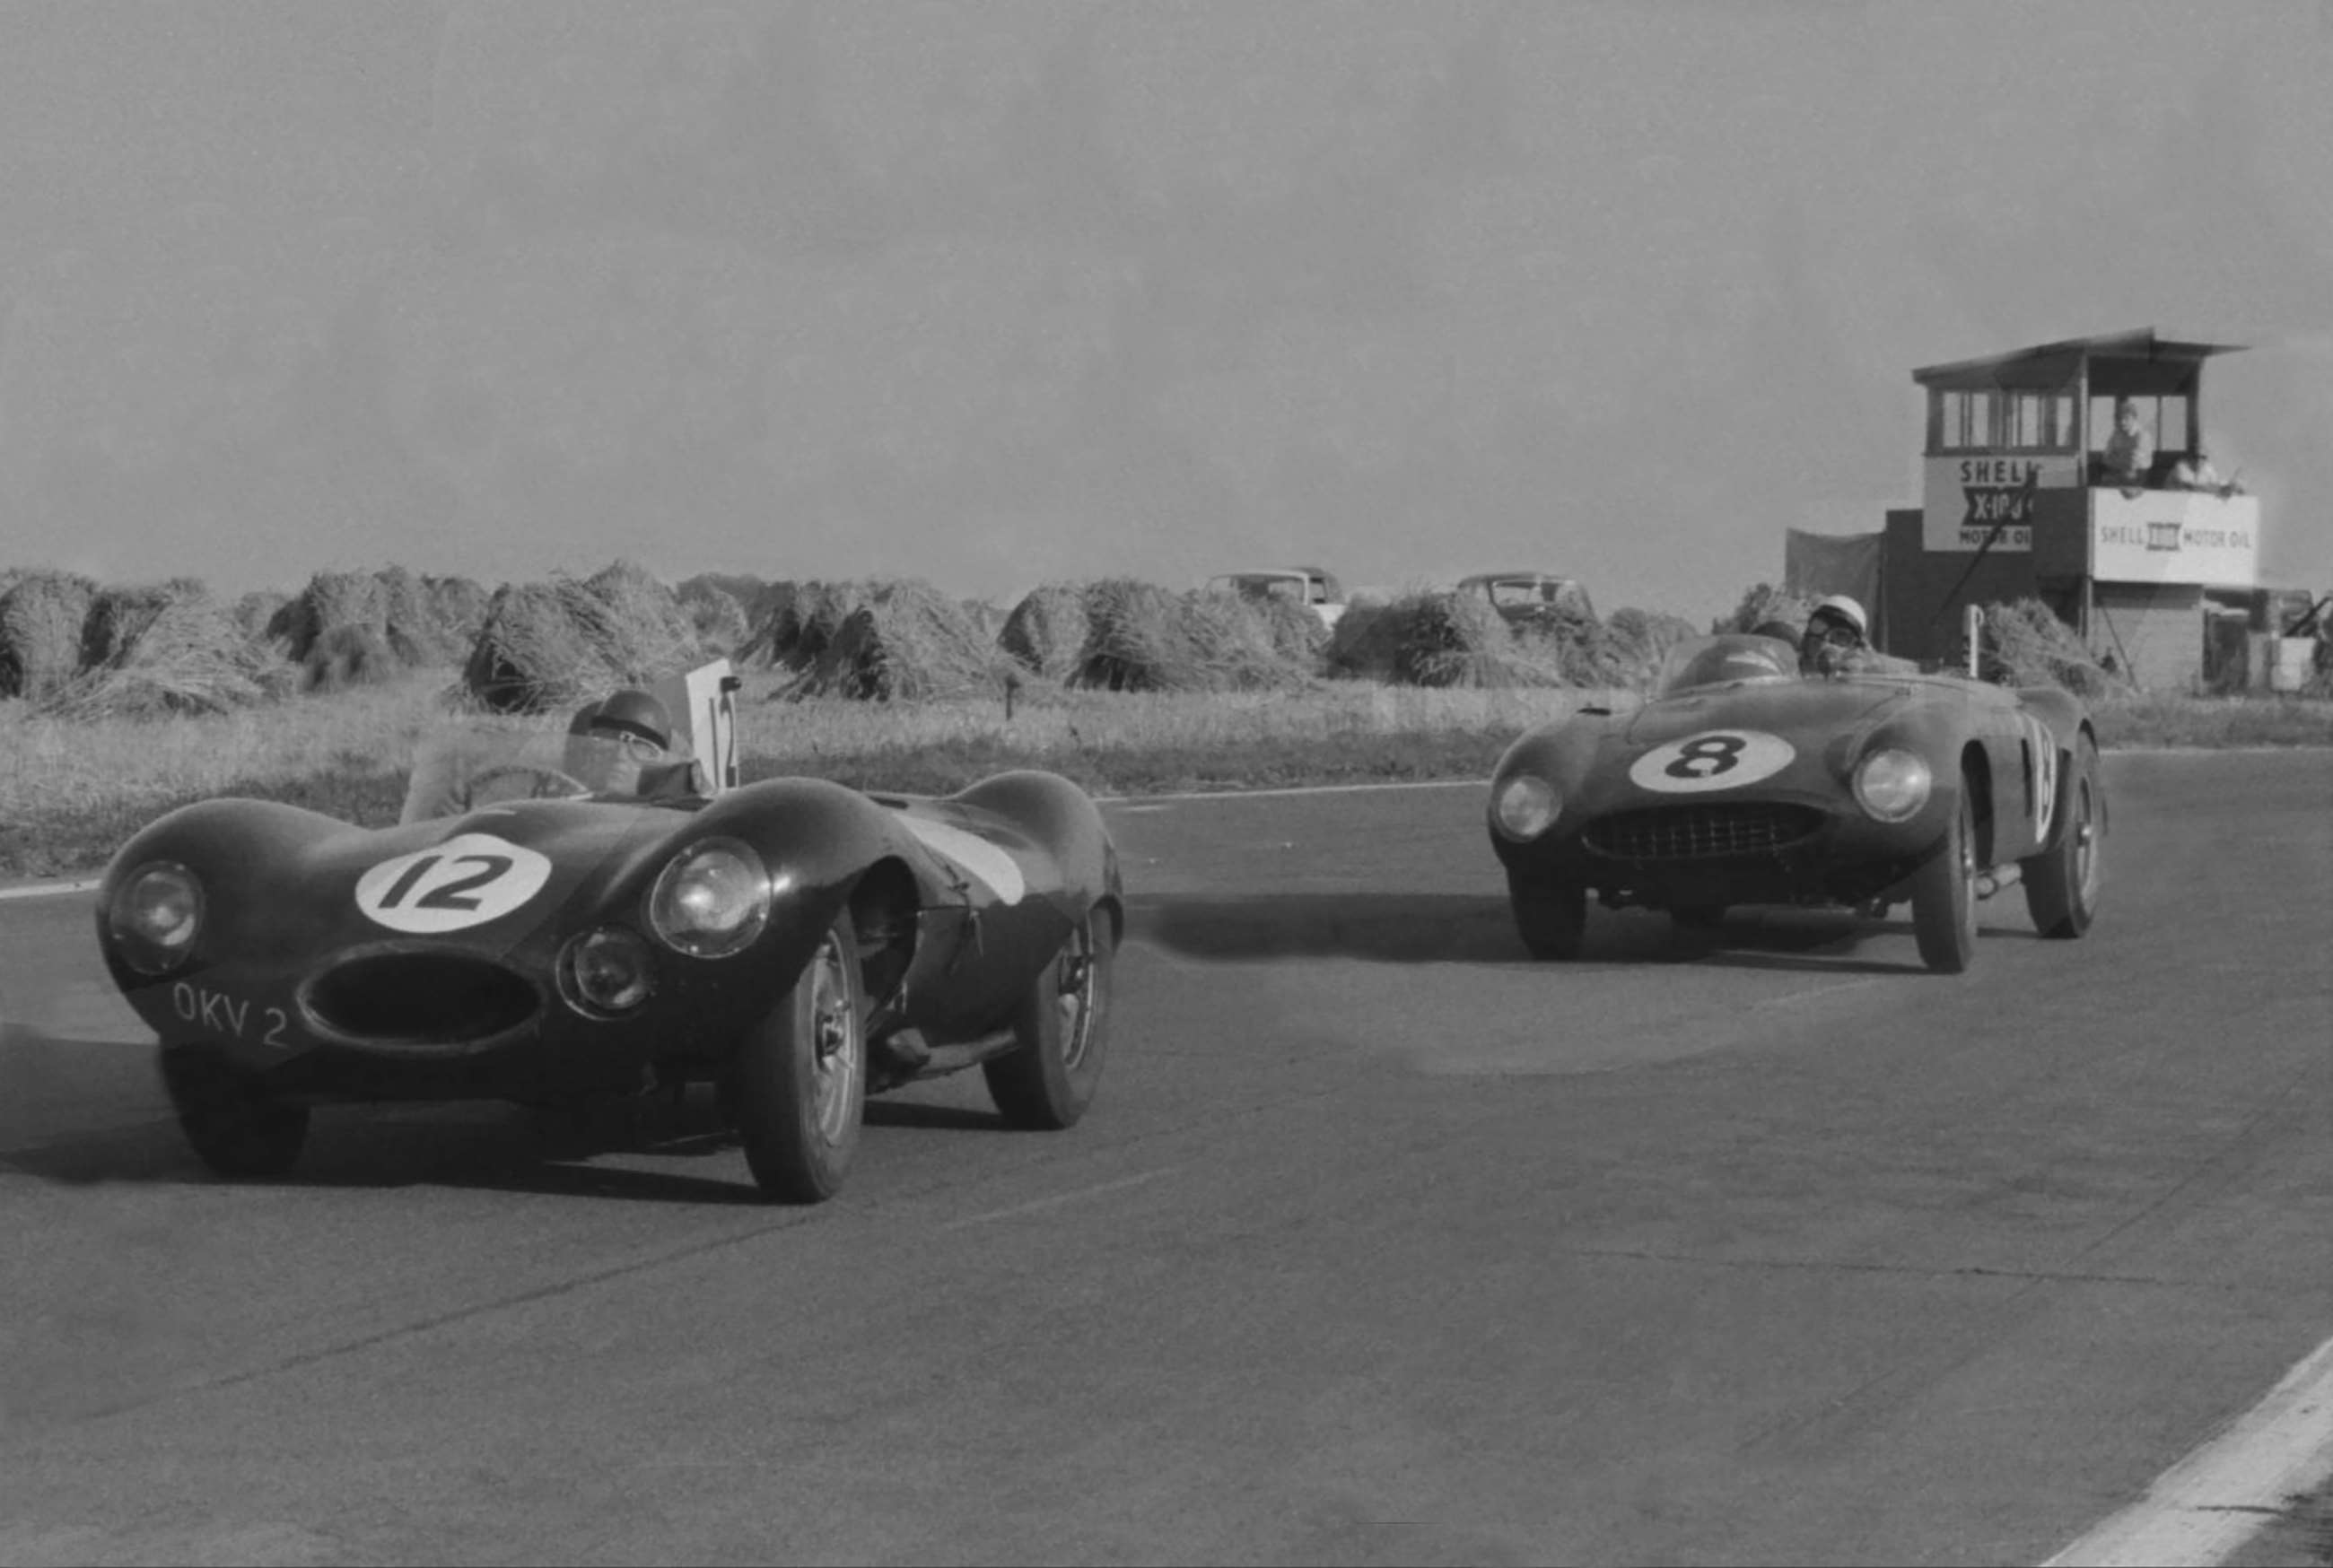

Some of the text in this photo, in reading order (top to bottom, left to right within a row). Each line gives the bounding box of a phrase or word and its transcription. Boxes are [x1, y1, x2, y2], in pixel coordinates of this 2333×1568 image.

[1960, 459, 2034, 483] SHELL
[1960, 530, 2031, 544] MOTR OI
[2101, 526, 2145, 545] SHELL
[2183, 529, 2226, 548] MOTOR
[2228, 530, 2251, 549] OIL
[1665, 736, 1748, 779] 8
[377, 855, 514, 911] 12
[173, 982, 290, 1049] OKV 2
